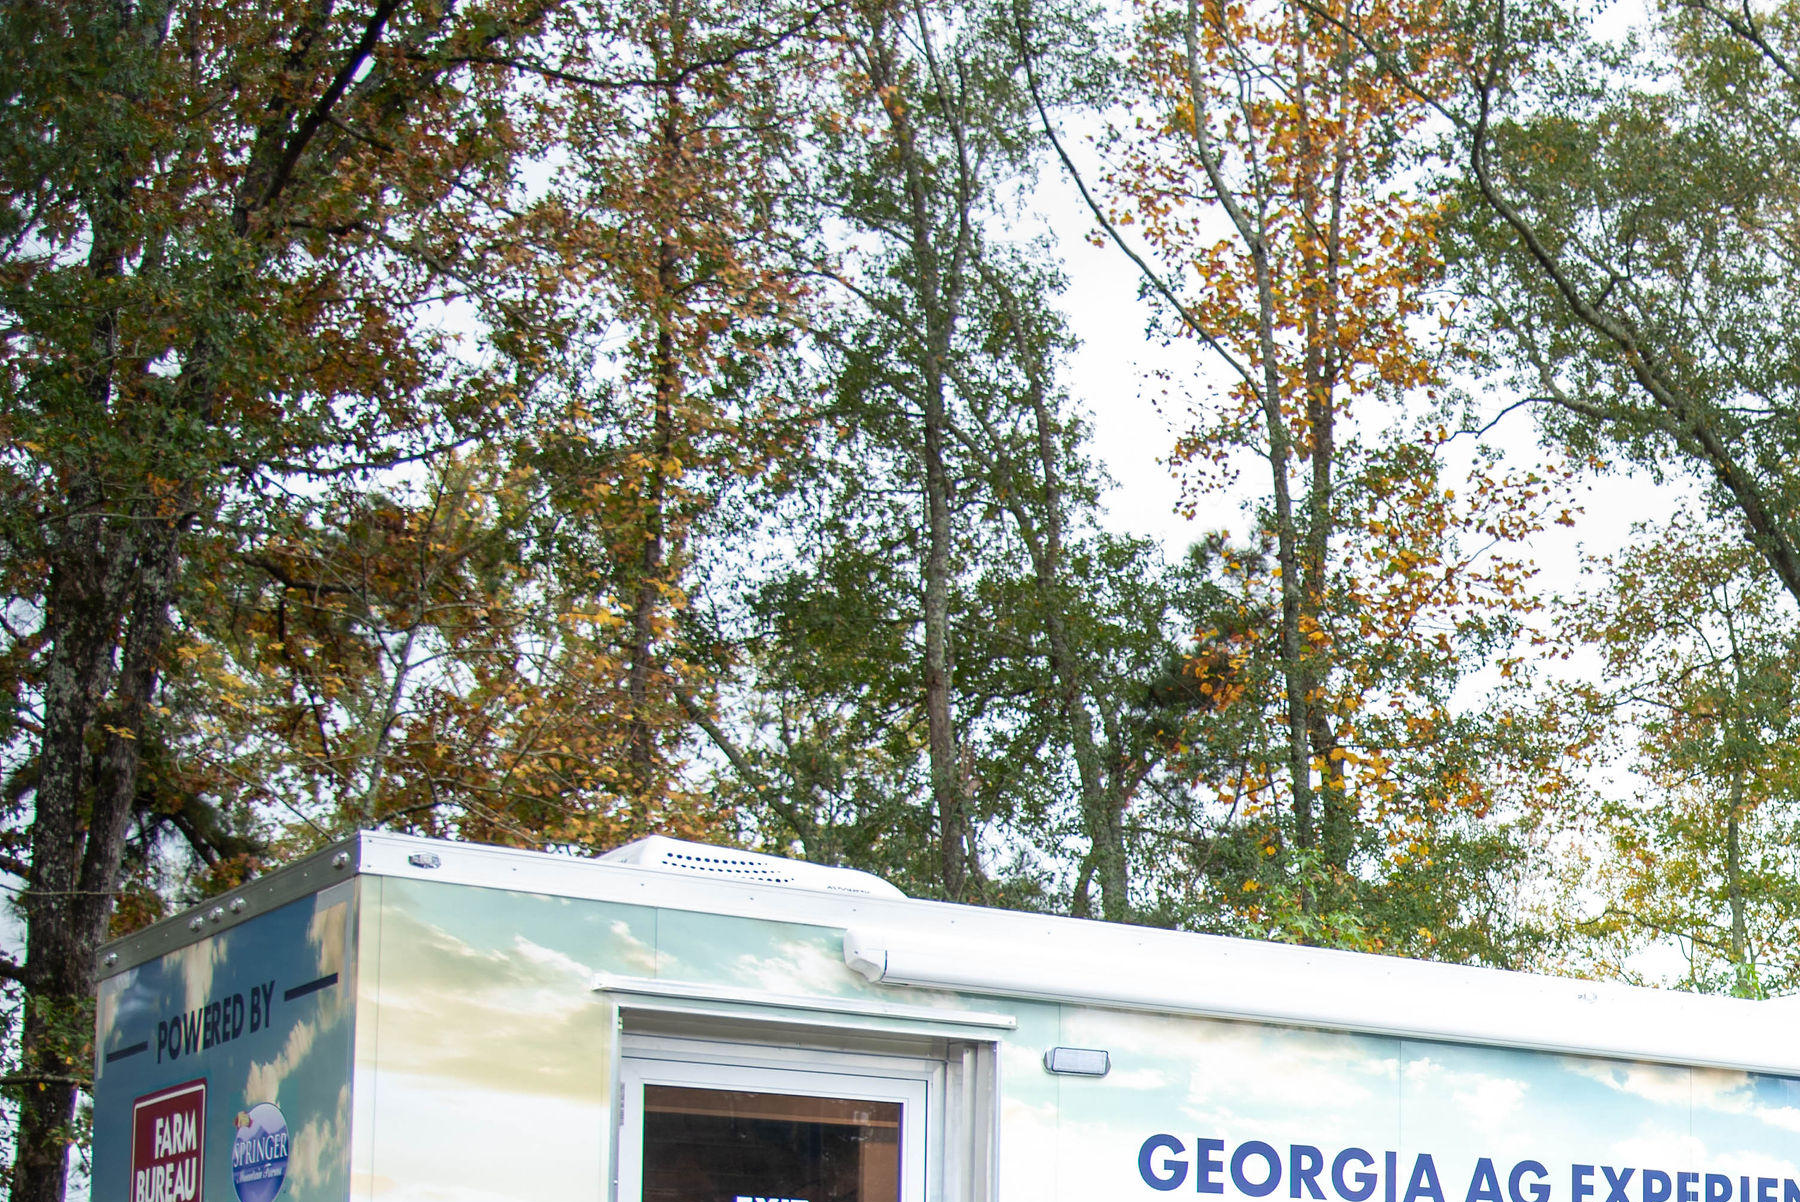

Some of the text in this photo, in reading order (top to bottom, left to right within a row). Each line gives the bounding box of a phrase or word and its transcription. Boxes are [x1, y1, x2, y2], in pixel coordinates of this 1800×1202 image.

[157, 980, 276, 1064] POWERED BY
[154, 1109, 197, 1160] FARM
[232, 1132, 289, 1168] SPRINGER
